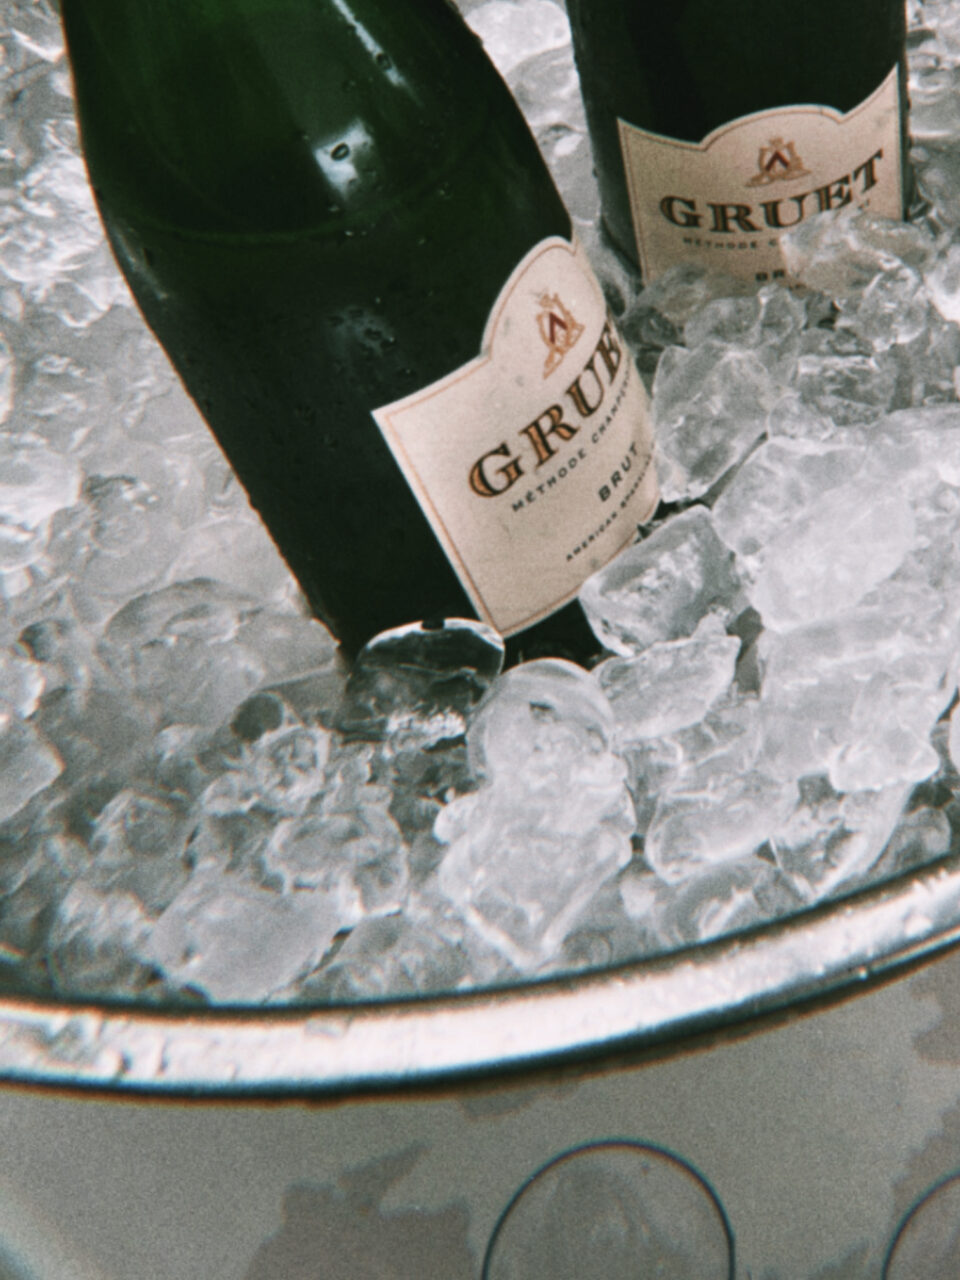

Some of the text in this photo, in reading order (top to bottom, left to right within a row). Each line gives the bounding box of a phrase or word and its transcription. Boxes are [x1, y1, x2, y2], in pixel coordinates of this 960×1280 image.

[659, 147, 884, 233] GRUET
[468, 310, 623, 498] GRUE
[511, 448, 587, 513] MÉTHODE
[598, 441, 639, 503] BRUT
[566, 511, 618, 563] AMERICAN
